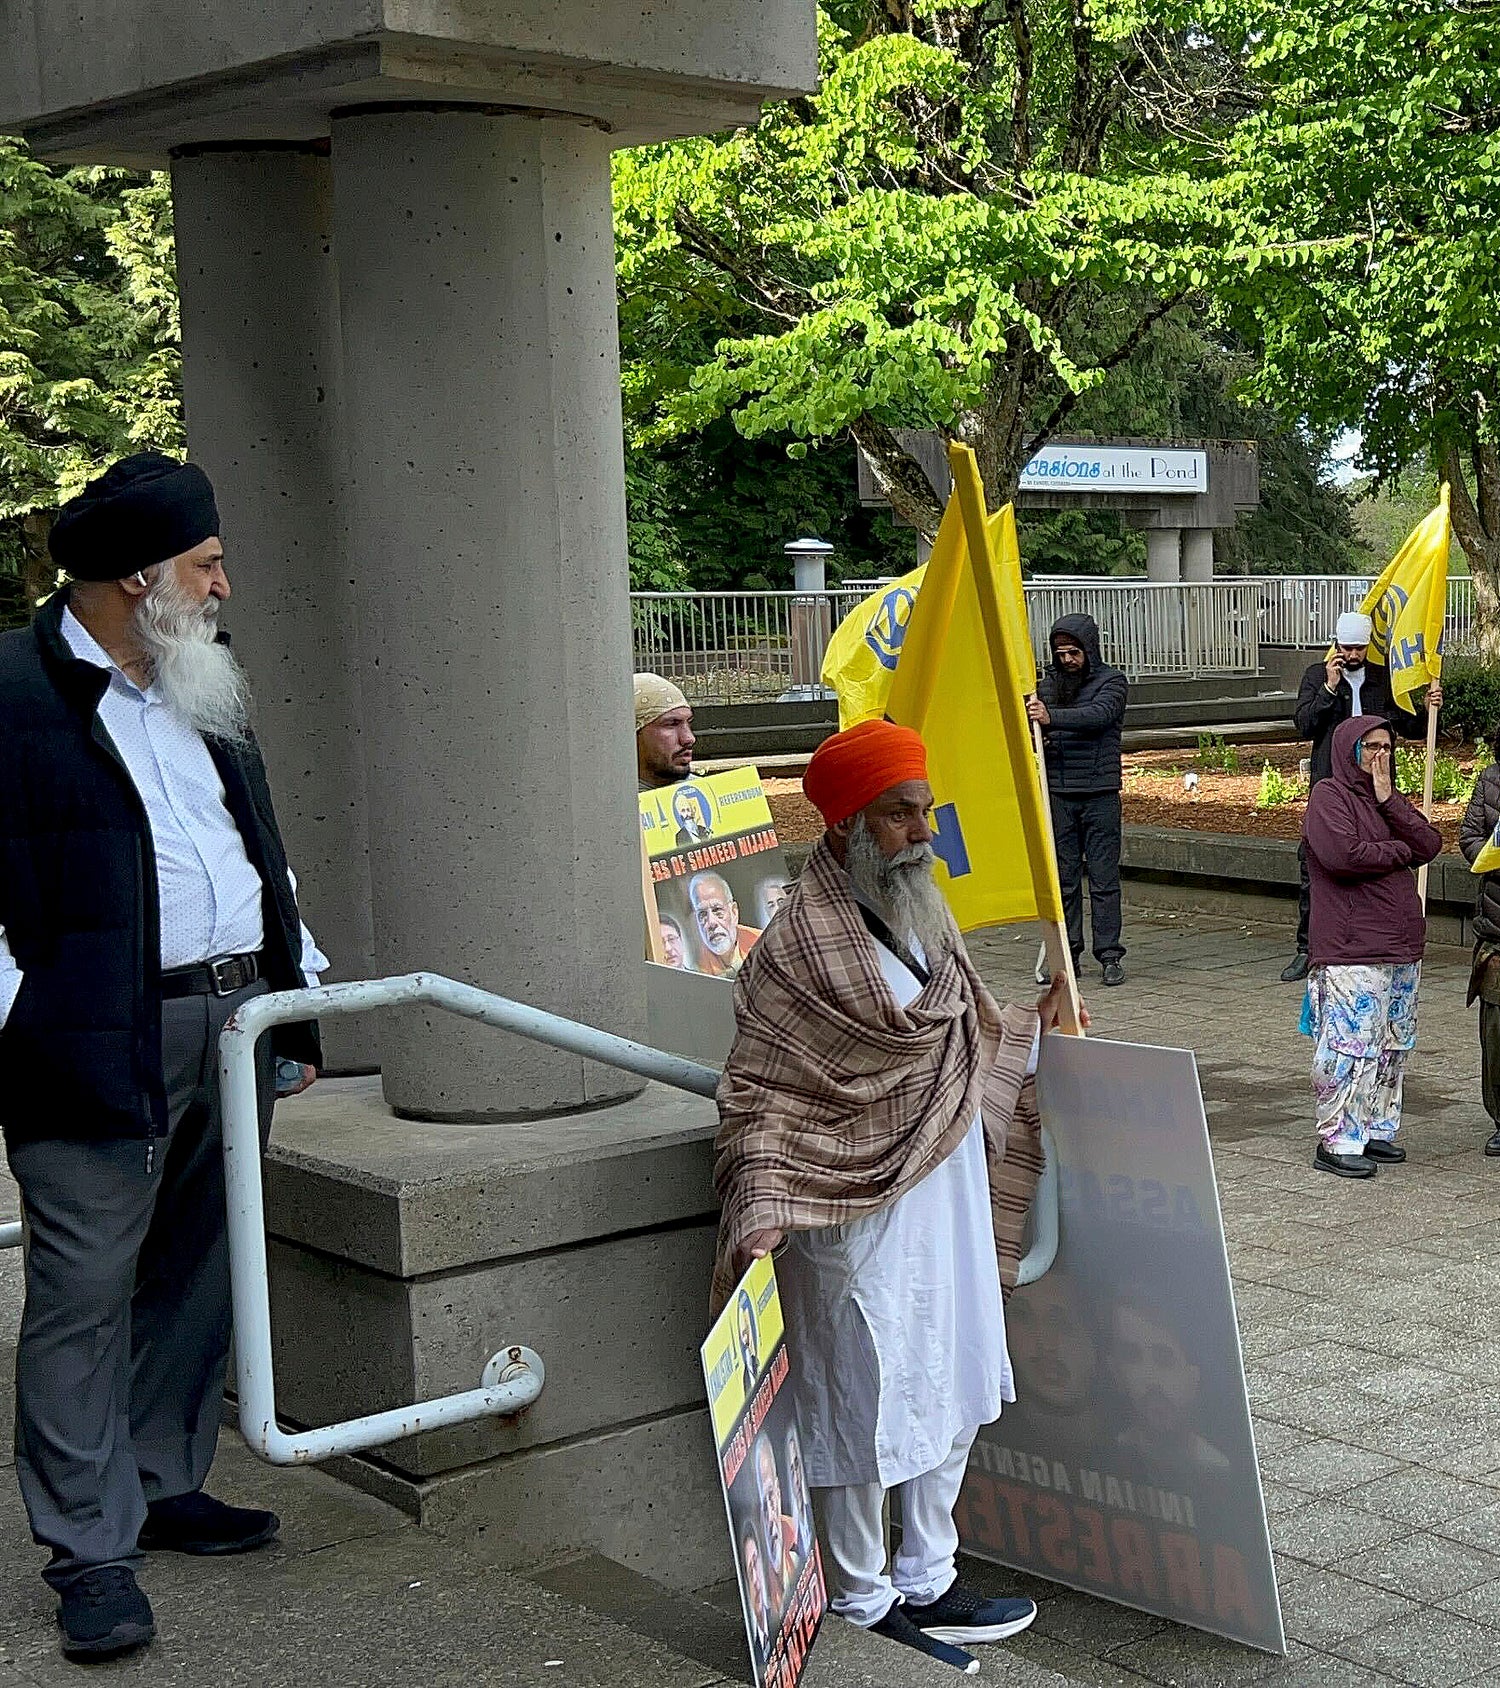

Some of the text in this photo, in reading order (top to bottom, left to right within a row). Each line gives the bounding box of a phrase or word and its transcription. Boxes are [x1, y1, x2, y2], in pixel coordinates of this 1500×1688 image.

[1023, 456, 1197, 479] casions at the Pond
[718, 786, 763, 807] REFERENDUM
[671, 854, 687, 877] OF
[689, 840, 738, 872] SHAHEED
[739, 829, 780, 858] NIJJAR
